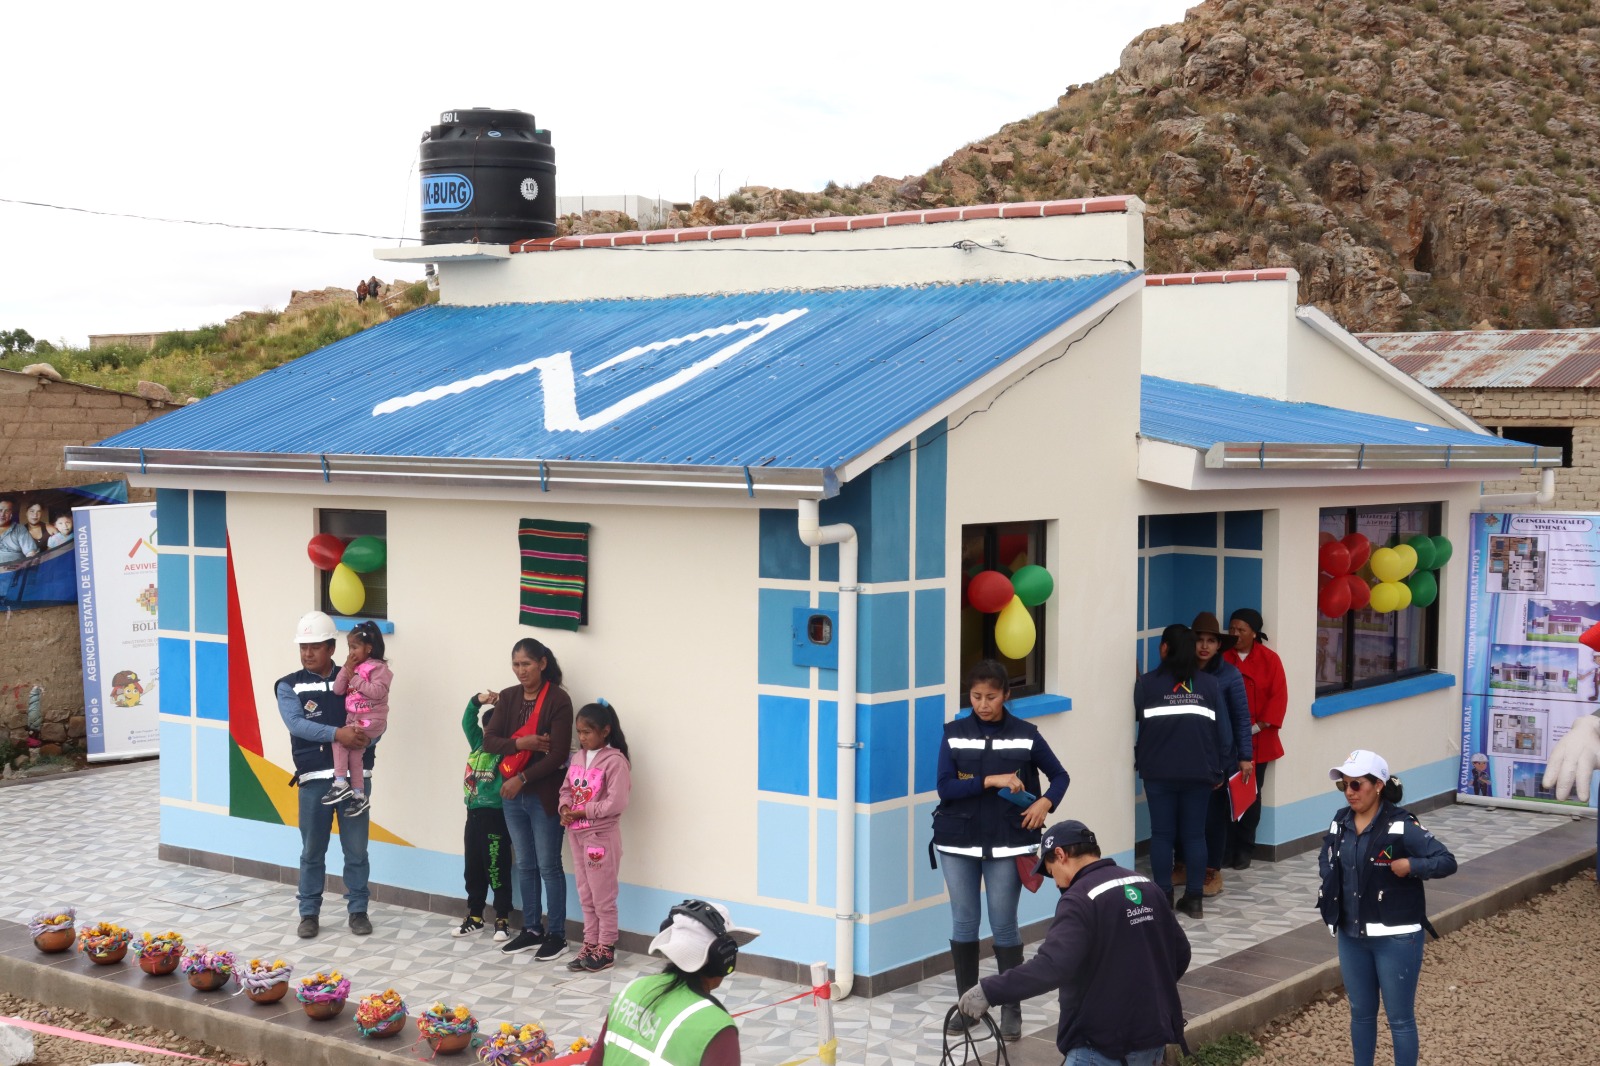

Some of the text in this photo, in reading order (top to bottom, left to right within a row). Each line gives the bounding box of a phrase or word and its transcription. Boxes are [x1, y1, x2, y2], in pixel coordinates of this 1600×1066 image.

[454, 112, 459, 122] L
[525, 182, 535, 192] 10
[124, 562, 158, 571] AEVIVIE
[1470, 574, 1479, 601] RURAL
[78, 525, 97, 682] AGENCIA ESTATAL DE VIVIENDA
[1469, 602, 1478, 629] NUEVA
[132, 621, 158, 632] BOLI
[1467, 631, 1477, 669] VIVIENDA
[1463, 705, 1473, 733] RURAL
[1460, 734, 1471, 785] CUALITATIVA
[615, 998, 662, 1042] PRENSA
